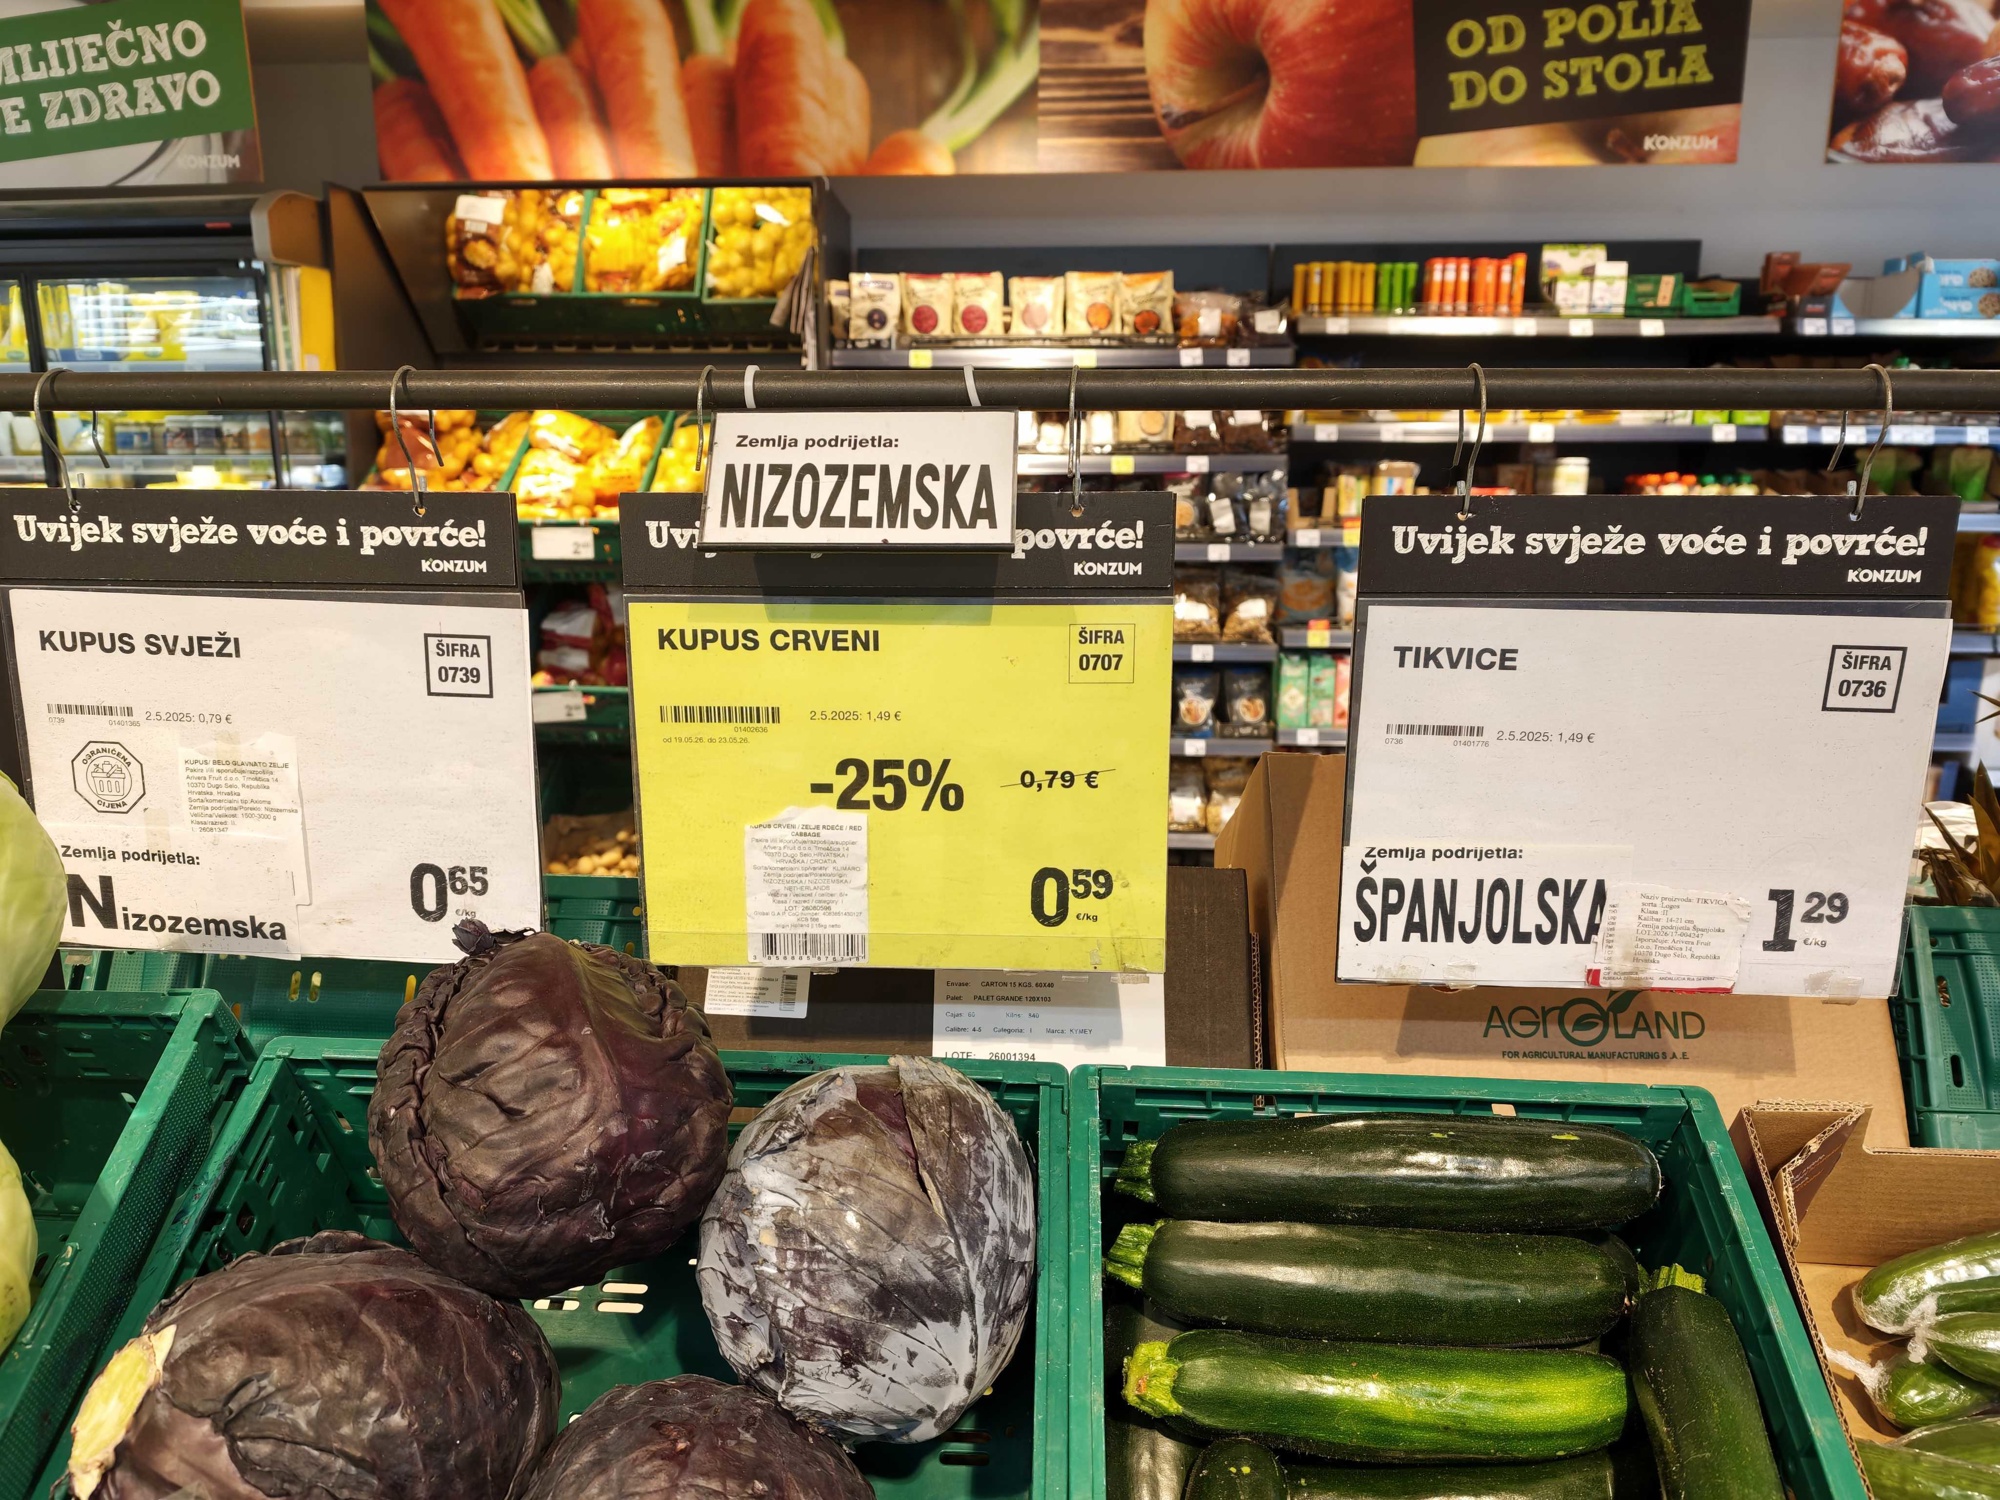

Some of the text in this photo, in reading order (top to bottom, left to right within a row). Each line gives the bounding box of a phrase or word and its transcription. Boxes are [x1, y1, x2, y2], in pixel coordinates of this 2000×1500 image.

[1446, 0, 1702, 58] OD POLJA
[1449, 45, 1714, 110] DO STOLA
[0, 69, 221, 135] E ZDRAVO
[1643, 134, 1718, 151] KONZUM
[736, 435, 899, 450] Zemlja podrijetla:
[720, 462, 998, 529] NIZOZEMSKA
[13, 515, 487, 555] Uvijek svježe voće i povrće!
[645, 520, 701, 549] Uvi
[1011, 520, 1144, 559] povrće!
[1392, 525, 1928, 565] Uvijek svježe voće i povrće!
[422, 558, 487, 572] KONZUM
[1074, 561, 1142, 575] KONZUM
[1847, 568, 1921, 583] KONZUM
[39, 630, 242, 658] KUPUS SVJEŽI
[658, 629, 880, 652] KUPUS CRVENI
[1078, 627, 1125, 645] ŠIFRA
[436, 639, 481, 658] ŠIFRA
[1079, 653, 1123, 671] 0707
[1393, 646, 1519, 670] TIKVICE
[1842, 651, 1892, 670] ŠIFRA
[438, 666, 481, 684] 0739
[1838, 680, 1887, 698] 0736
[145, 711, 232, 724] 2.5.2025: 0,79 €
[810, 711, 901, 723] 2.5.2025: 1,49 €
[1496, 730, 1595, 744] 2.5.2025: 1,49 €
[810, 758, 965, 812] -25%
[1020, 770, 1099, 792] 0,79 €
[97, 799, 127, 809] CIJENA
[61, 845, 200, 866] Zemlja podrijetla:
[1364, 847, 1524, 862] Zemlja podrijetla:
[66, 873, 287, 941] Nizozemska
[1353, 859, 1607, 946] ŠPANJOLSKA
[1076, 913, 1098, 922] €/kg
[1803, 938, 1827, 947] €/kg
[988, 1052, 1036, 1061] 26001394
[1502, 1050, 1519, 1059] FOR
[1522, 1051, 1586, 1060] AGRICULTURAL
[1587, 1051, 1660, 1060] MANUFACTURING
